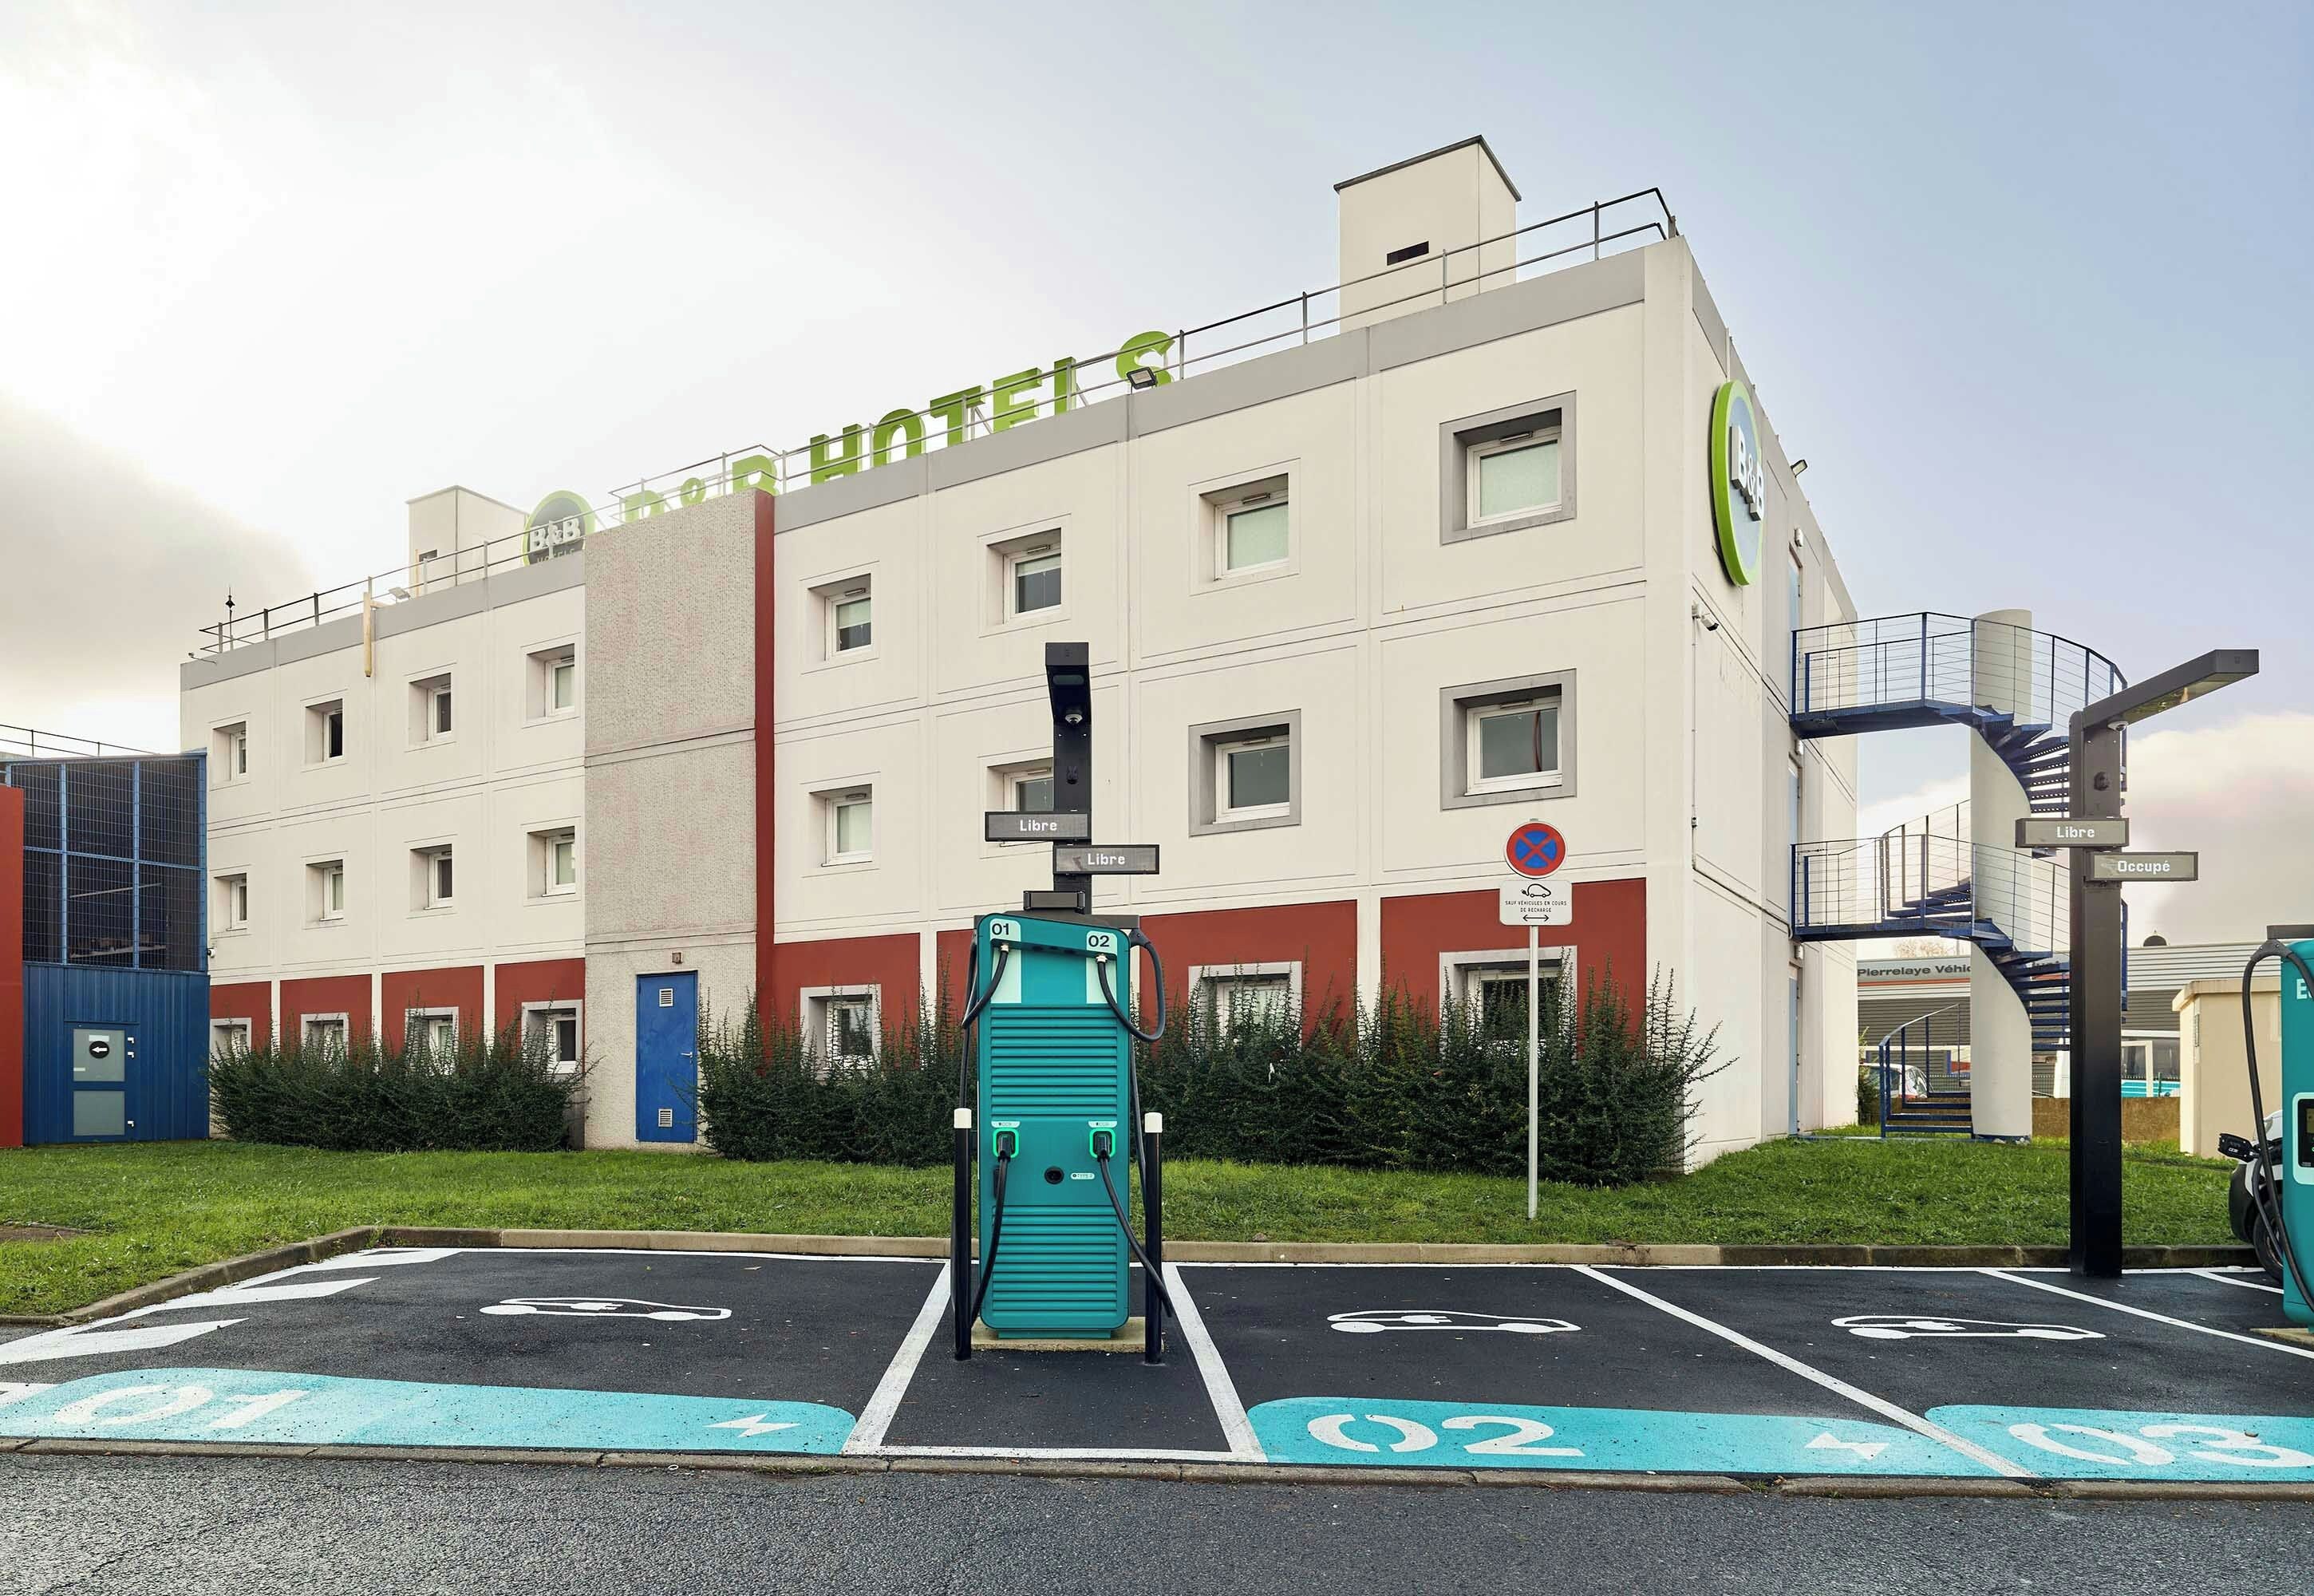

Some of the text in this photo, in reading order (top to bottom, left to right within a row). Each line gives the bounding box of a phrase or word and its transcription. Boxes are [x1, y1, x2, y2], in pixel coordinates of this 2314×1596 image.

[1730, 424, 1765, 523] B&B
[529, 516, 581, 552] B&B
[1019, 819, 1058, 832] Libre
[2056, 826, 2095, 838] Libre
[1088, 853, 1126, 865] Libre
[2117, 860, 2170, 875] Occupé
[991, 922, 1010, 935] 01
[1088, 934, 1110, 947] 02
[1858, 966, 1931, 978] Pierrelaye
[52, 1385, 310, 1428] 01
[1307, 1413, 1585, 1457] 02
[2008, 1423, 2314, 1468] 03
